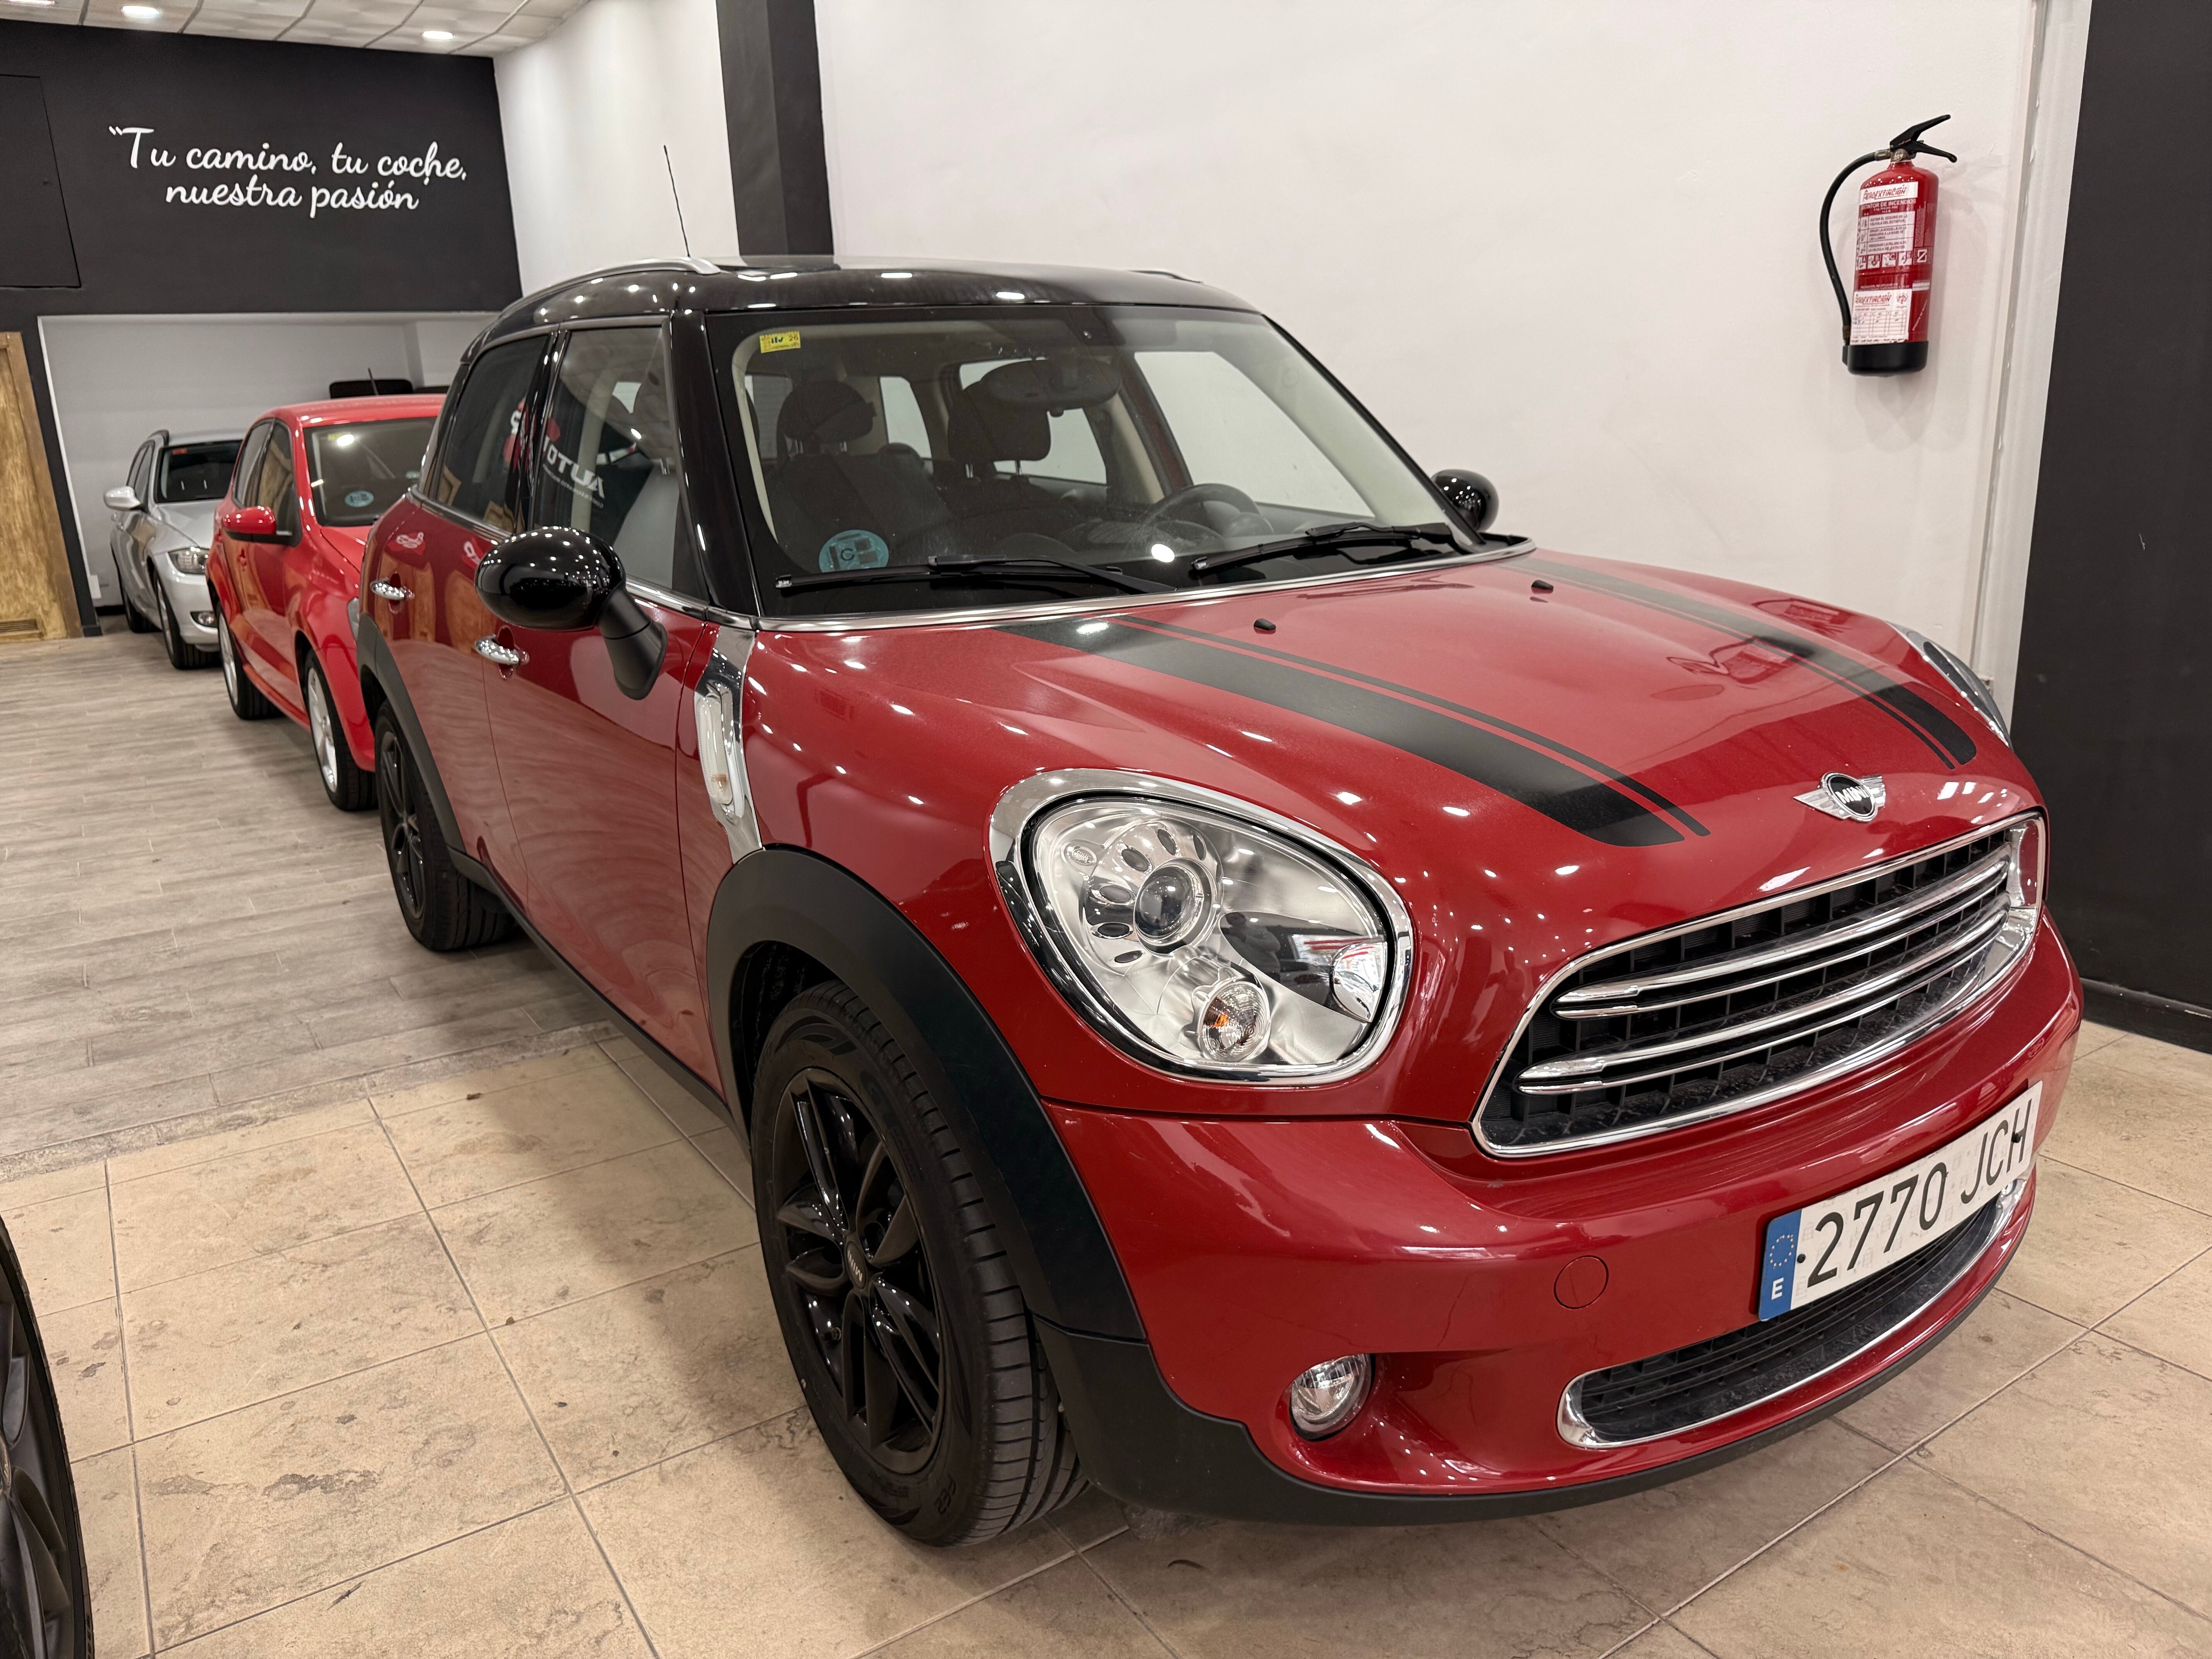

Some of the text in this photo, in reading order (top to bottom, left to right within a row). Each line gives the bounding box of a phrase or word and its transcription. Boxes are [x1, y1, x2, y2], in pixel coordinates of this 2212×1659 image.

[331, 142, 369, 174] tu
[377, 141, 467, 186] coche,
[166, 173, 420, 219] nuestra pasión
[1888, 198, 1916, 206] INCENDIOS
[1807, 1098, 2032, 1288] 2770 JCH
[1771, 1276, 1784, 1301] E
